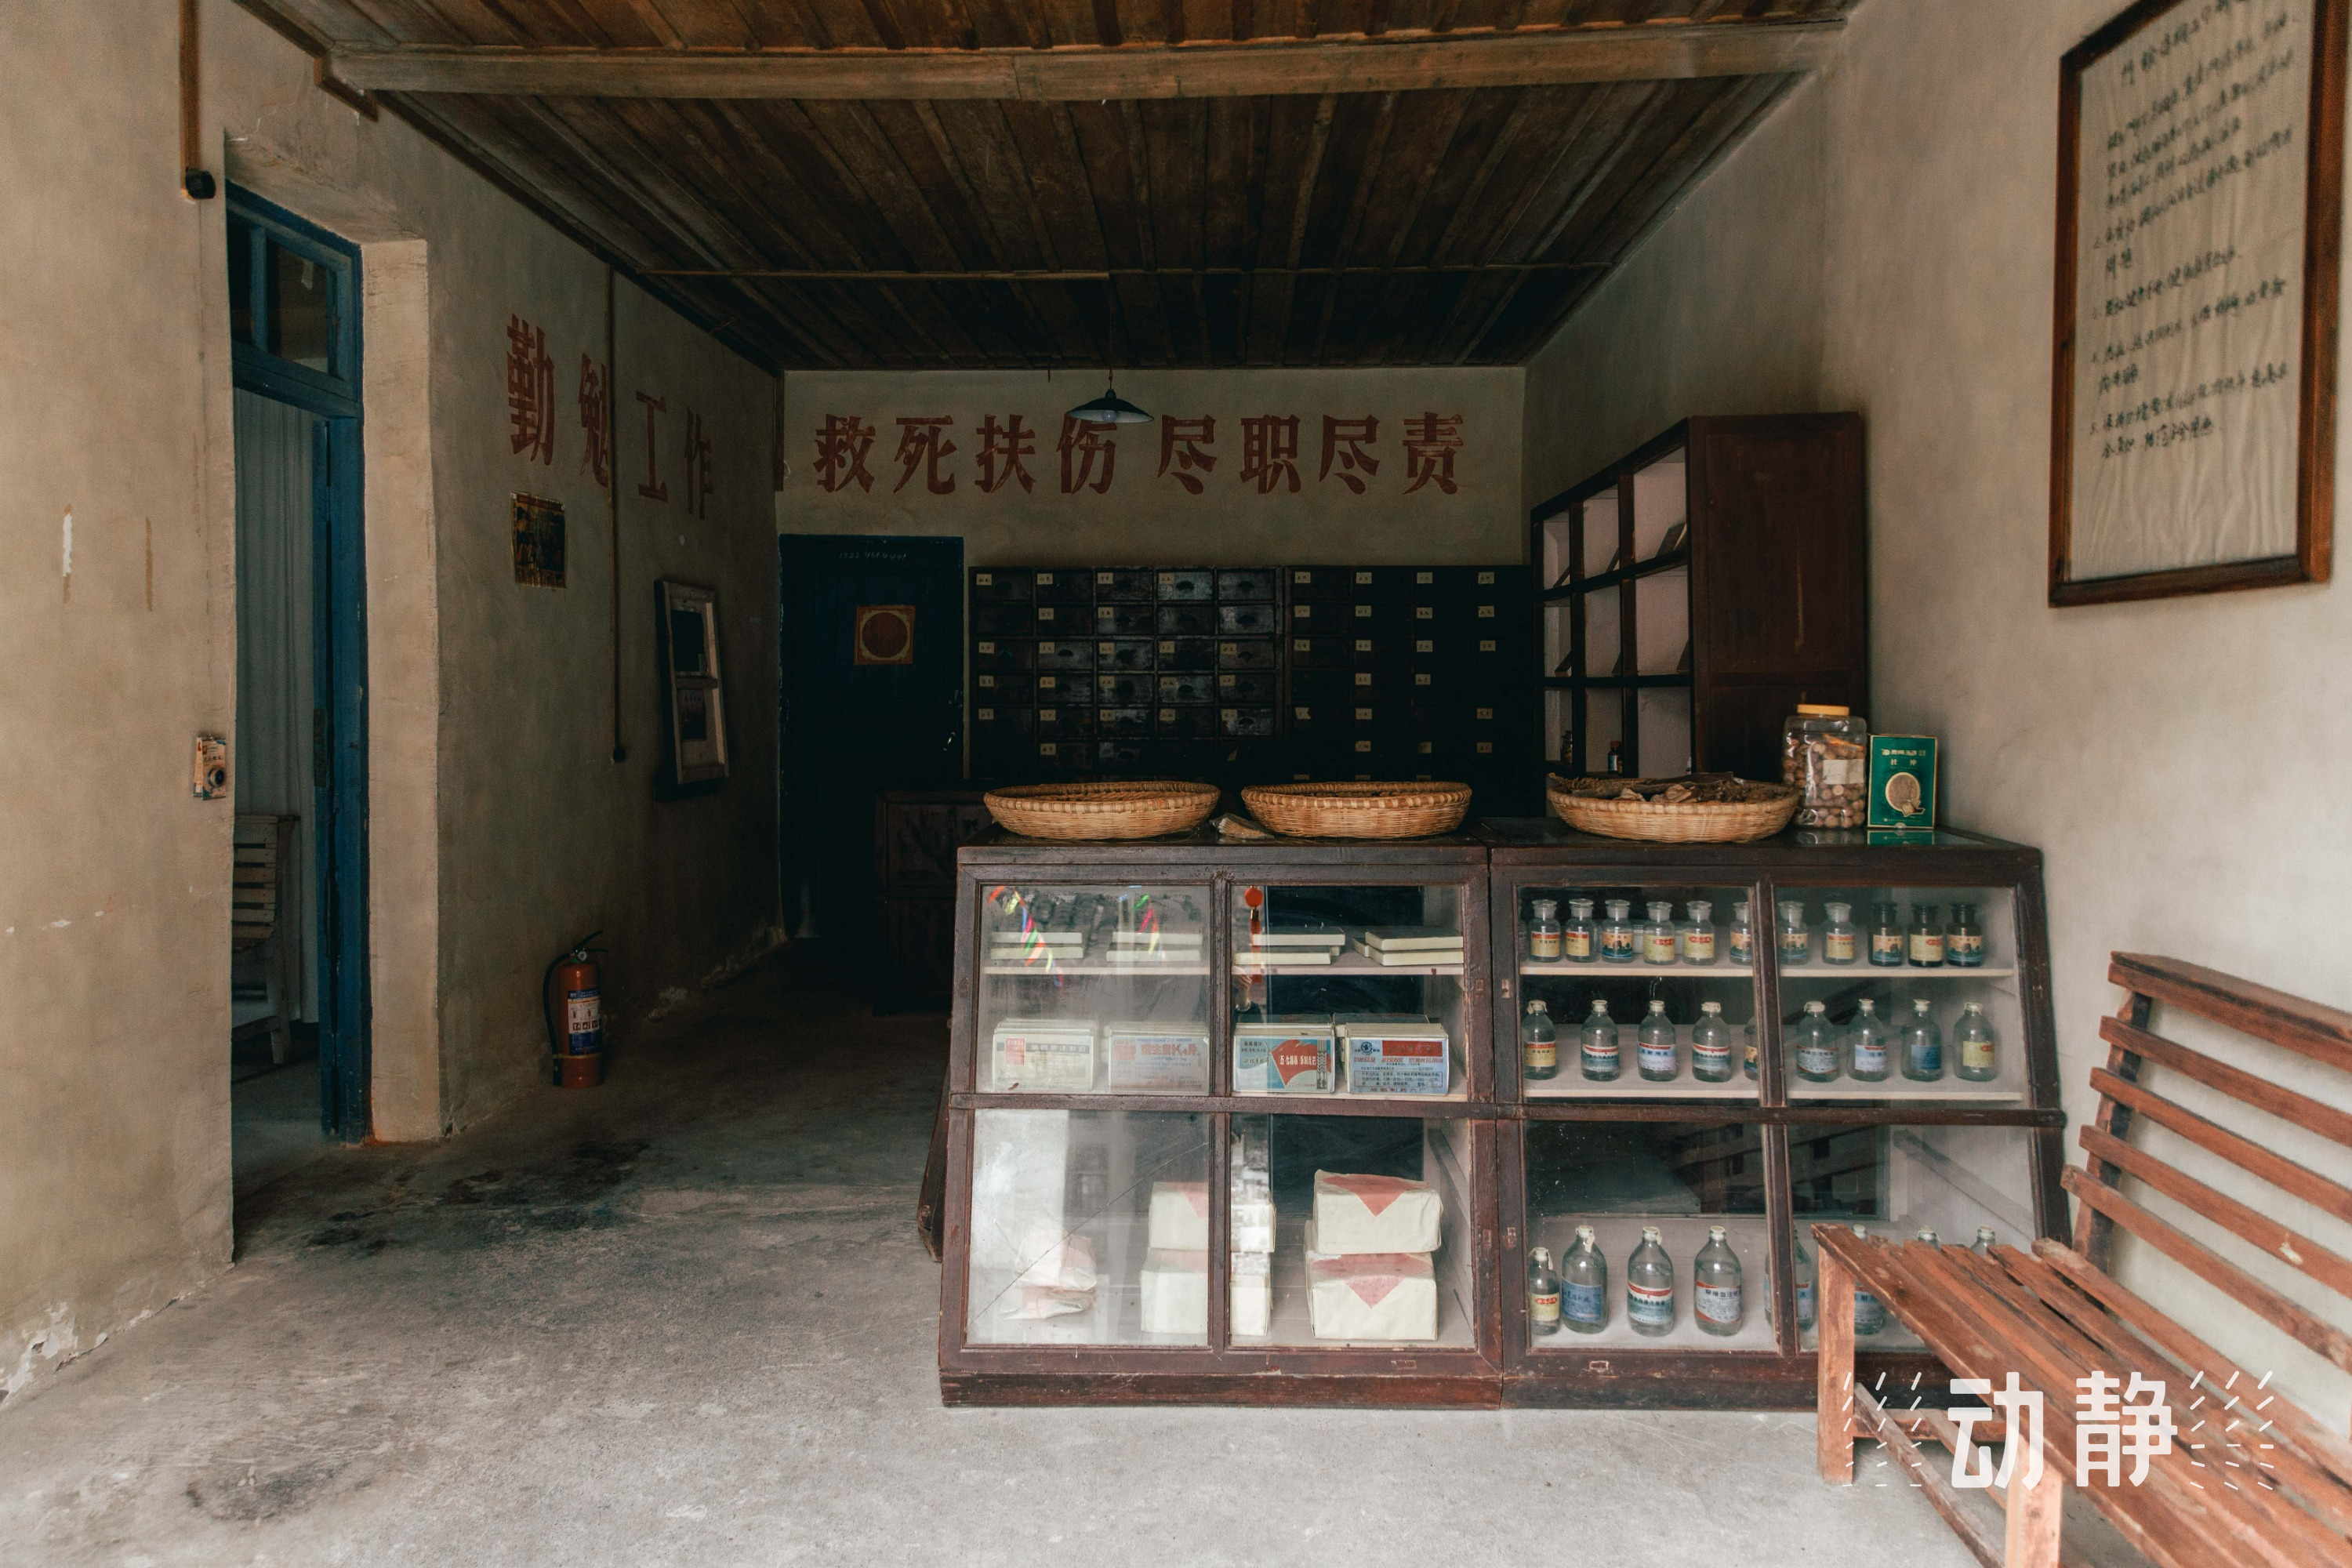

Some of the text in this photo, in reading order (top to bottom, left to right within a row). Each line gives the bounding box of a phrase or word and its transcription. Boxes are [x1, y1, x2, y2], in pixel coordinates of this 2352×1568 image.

[812, 411, 1465, 495] 救死扶伤 尽职尽责
